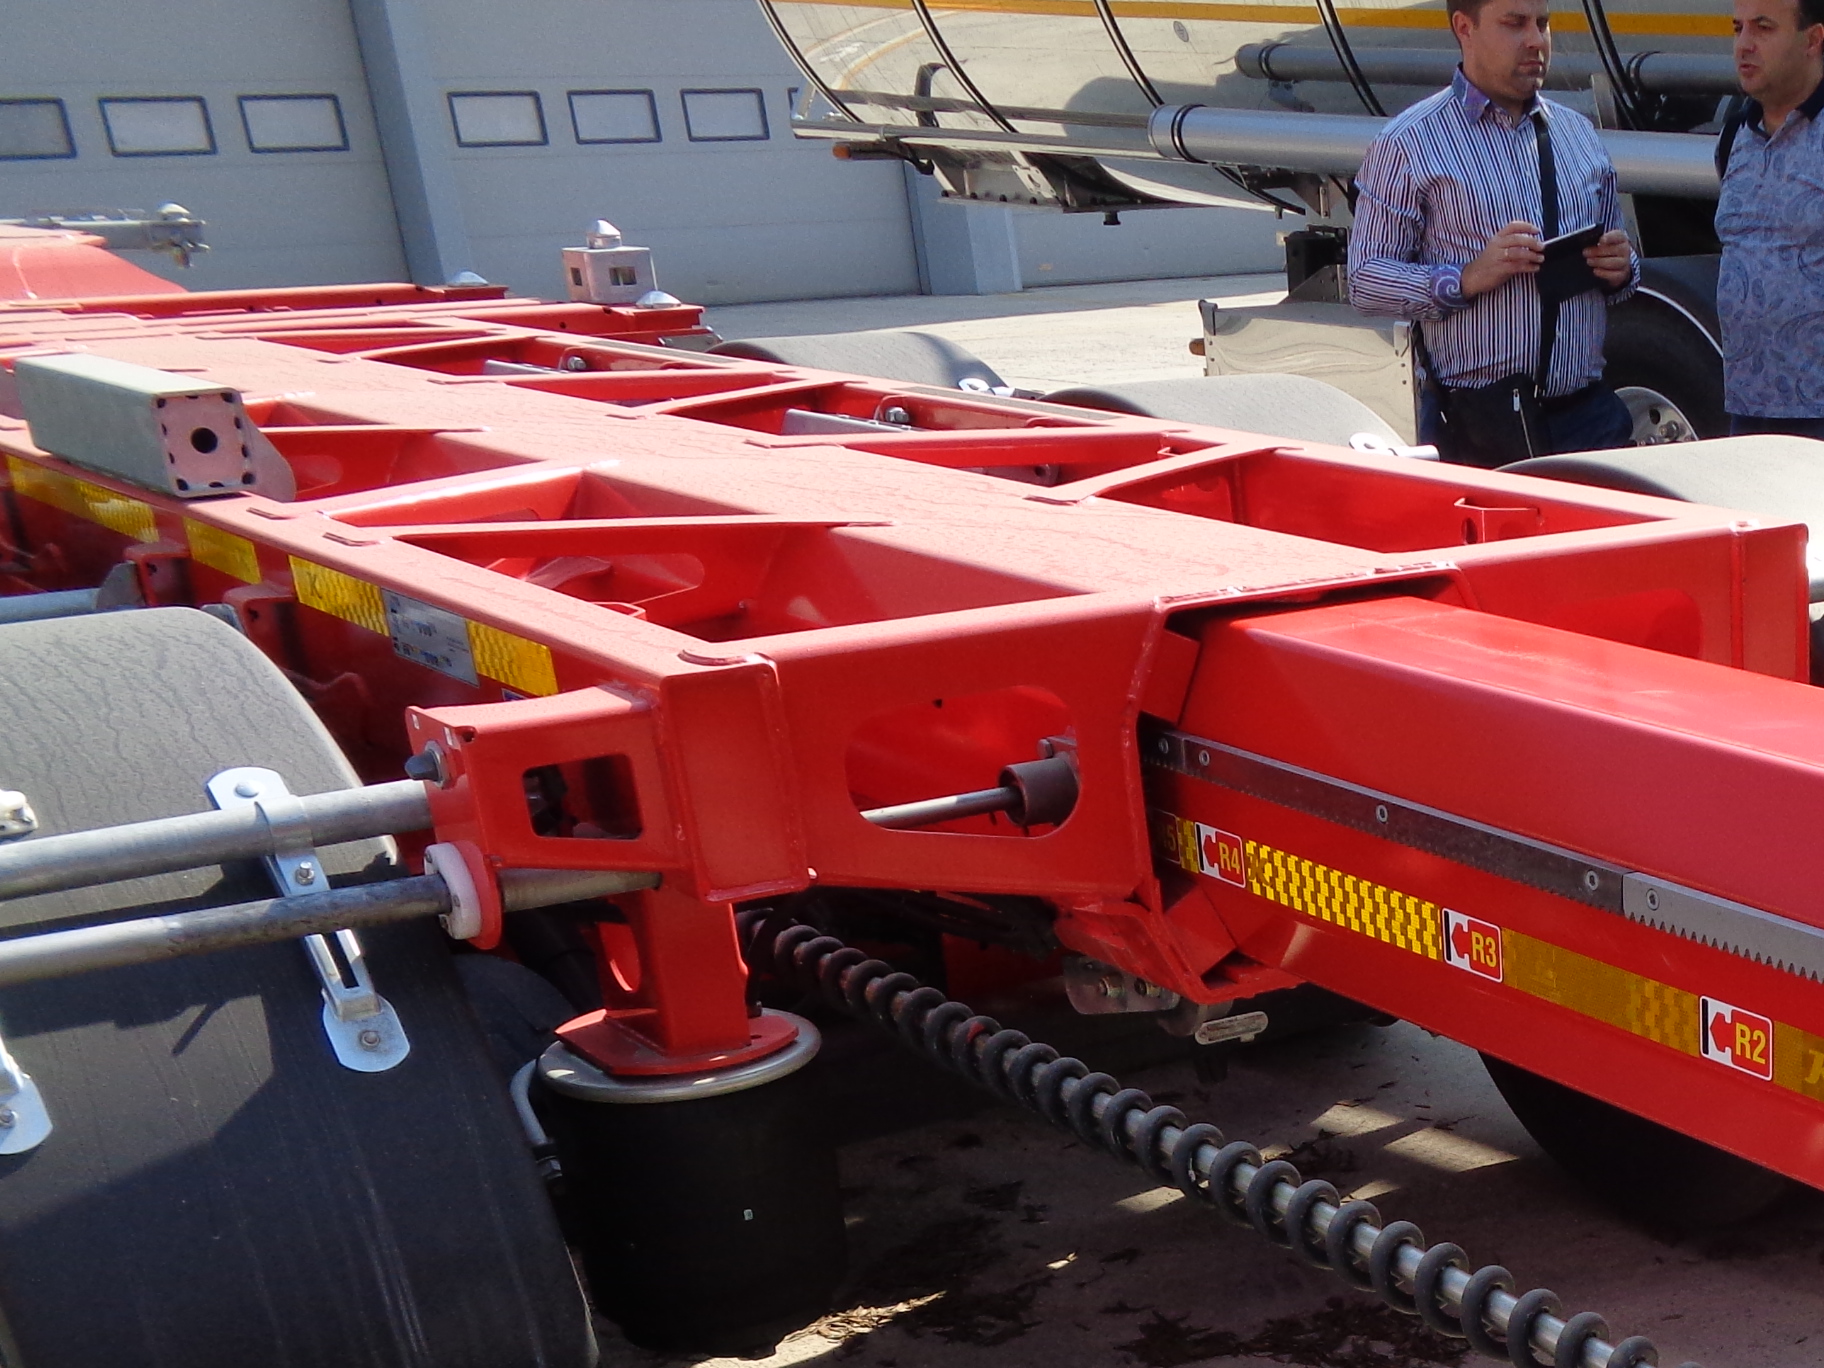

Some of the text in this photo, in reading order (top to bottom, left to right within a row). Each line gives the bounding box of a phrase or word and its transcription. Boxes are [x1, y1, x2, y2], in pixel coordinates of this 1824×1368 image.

[1218, 841, 1241, 875] R4
[1471, 930, 1497, 968] R3
[1735, 1022, 1767, 1065] R2
